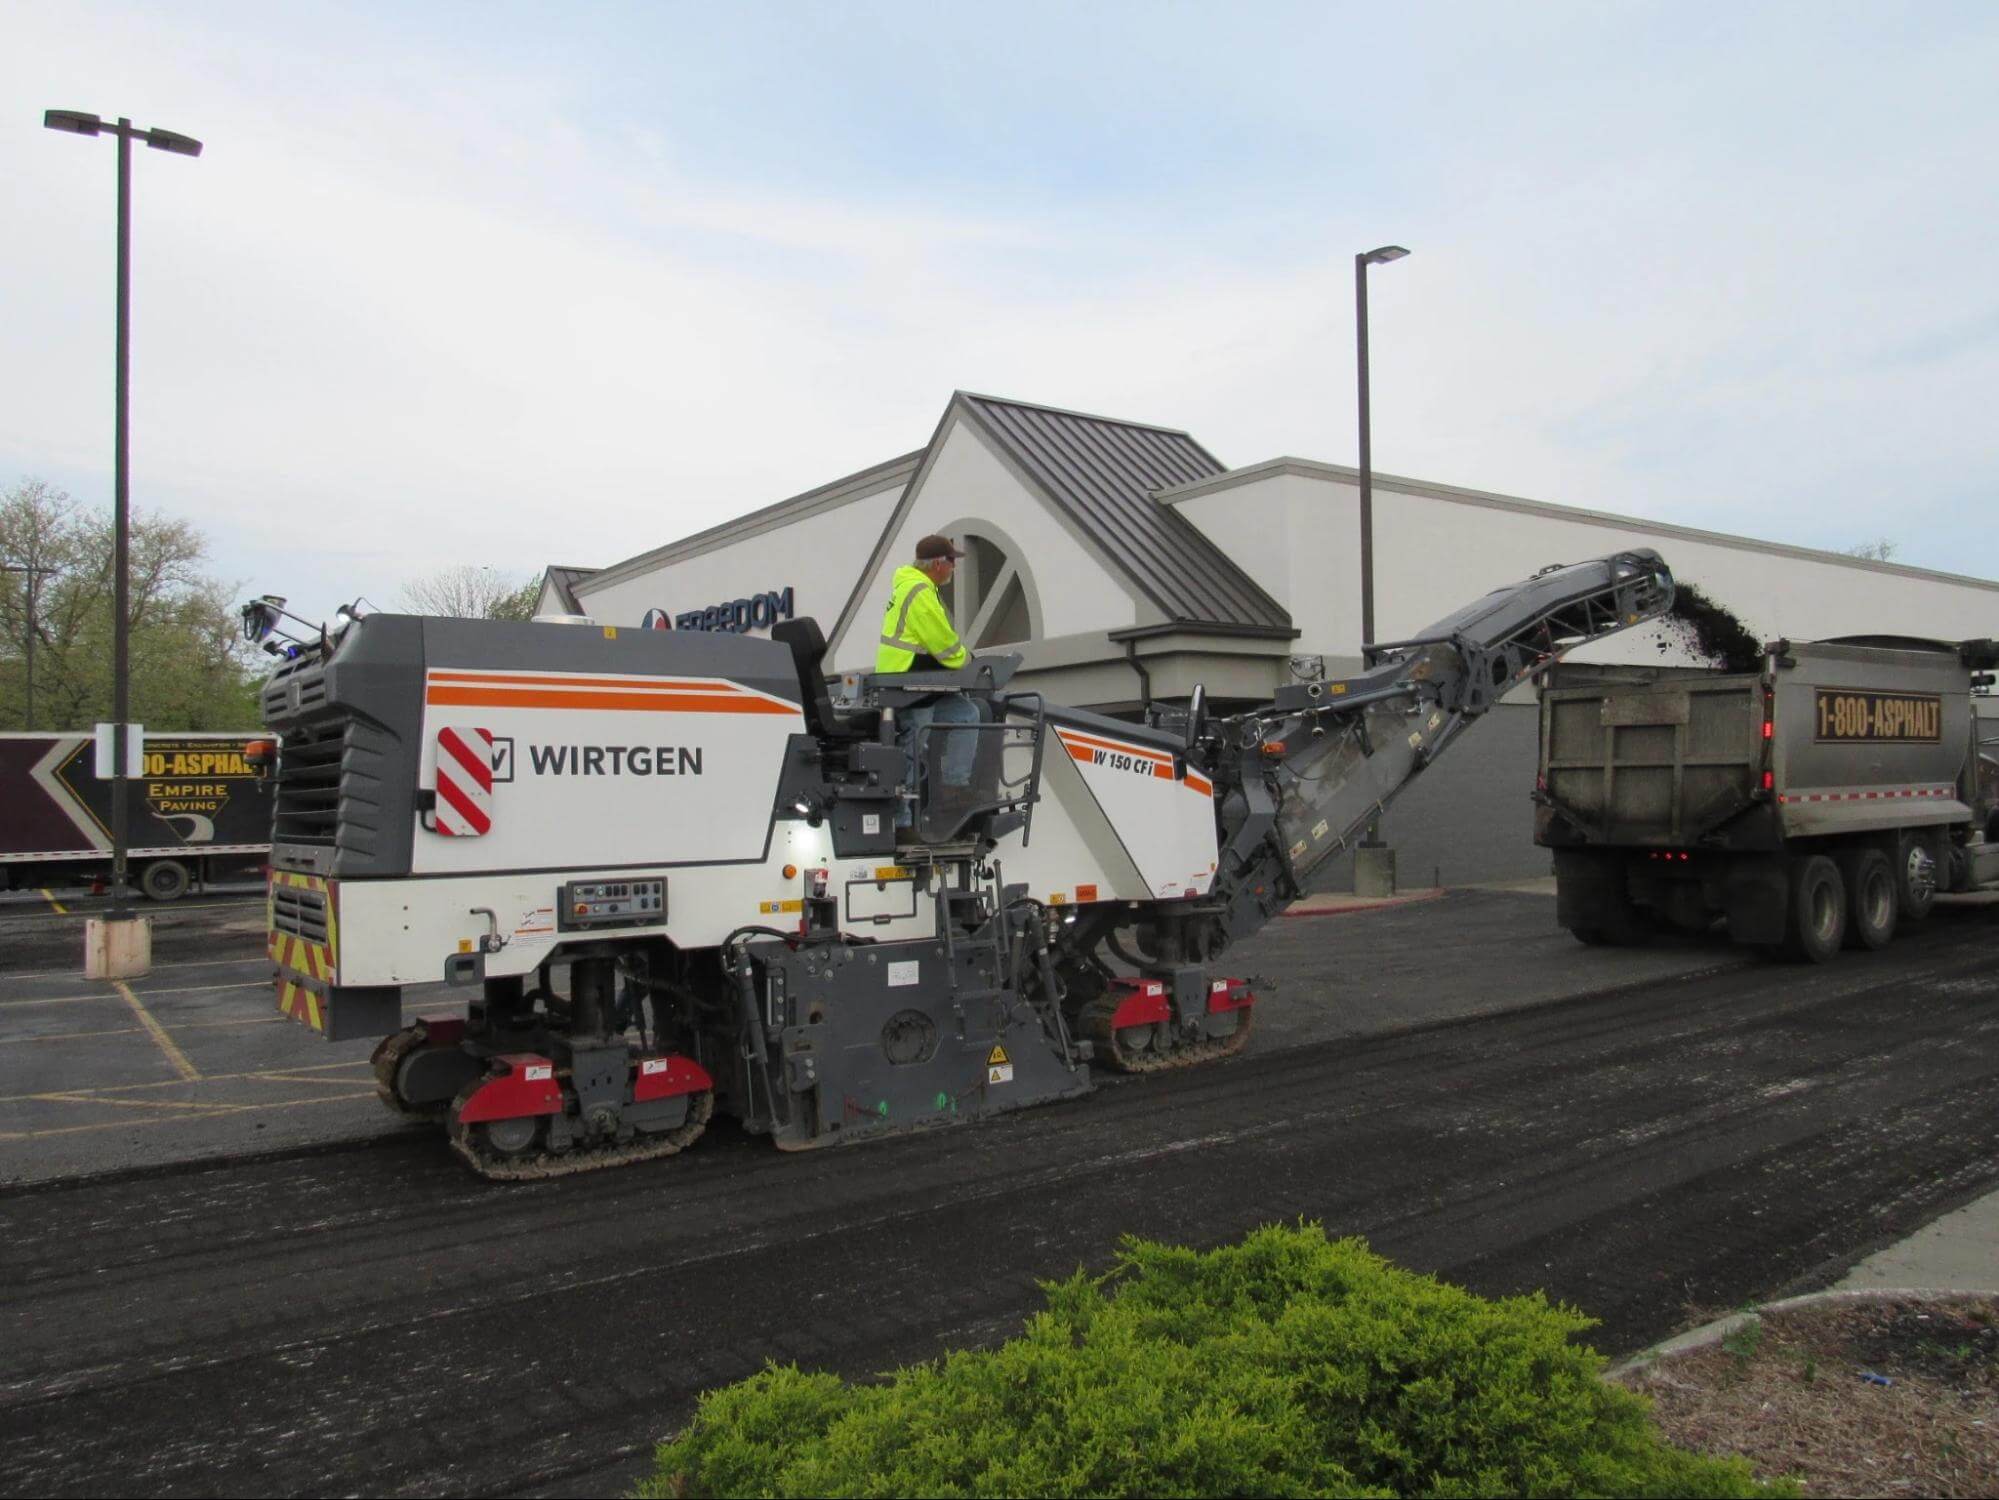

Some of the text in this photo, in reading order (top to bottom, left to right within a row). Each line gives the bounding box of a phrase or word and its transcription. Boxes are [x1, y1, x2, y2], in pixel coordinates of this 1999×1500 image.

[1819, 695, 1939, 737] 1-800-ASPHALT
[529, 745, 703, 776] WIRTGEN
[1094, 749, 1154, 776] W 150 CFi
[149, 783, 228, 797] EMPIRE
[160, 801, 217, 812] PAVING
